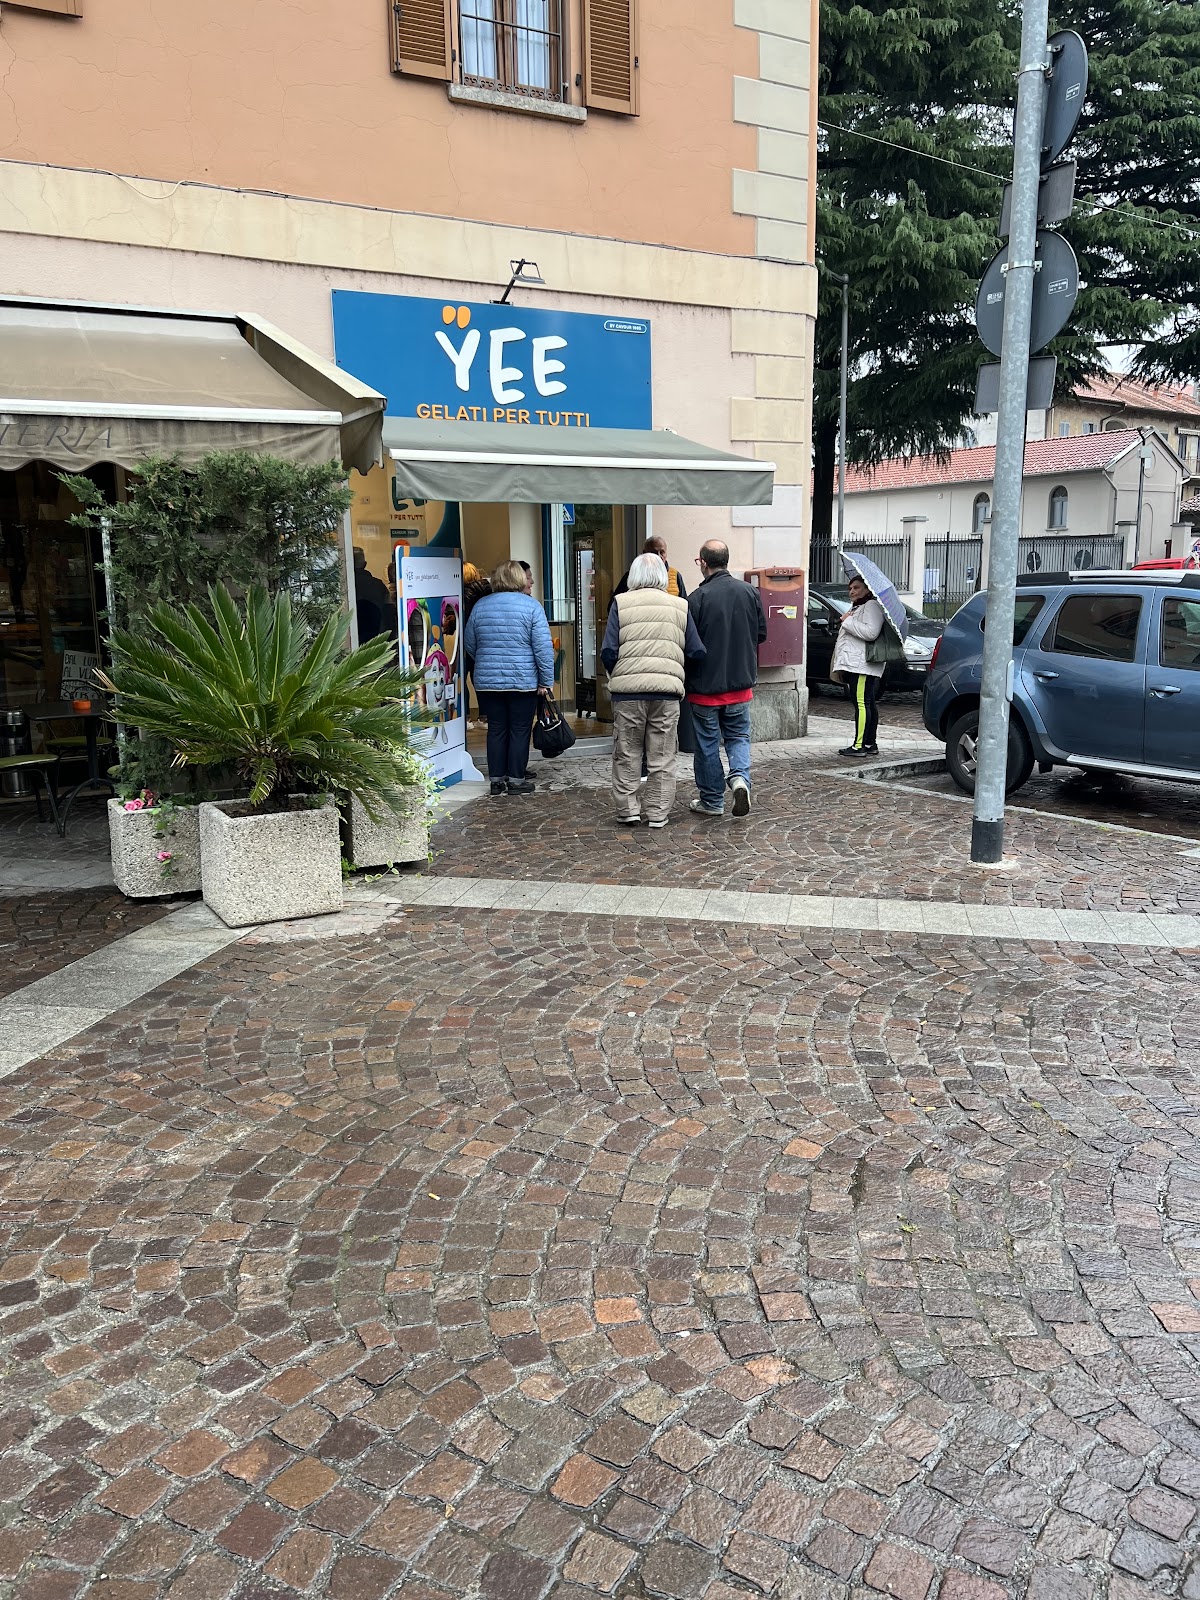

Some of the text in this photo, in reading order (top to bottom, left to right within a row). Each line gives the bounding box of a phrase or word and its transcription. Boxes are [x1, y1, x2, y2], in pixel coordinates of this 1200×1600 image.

[416, 403, 590, 427] GELATI PER TUTTI
